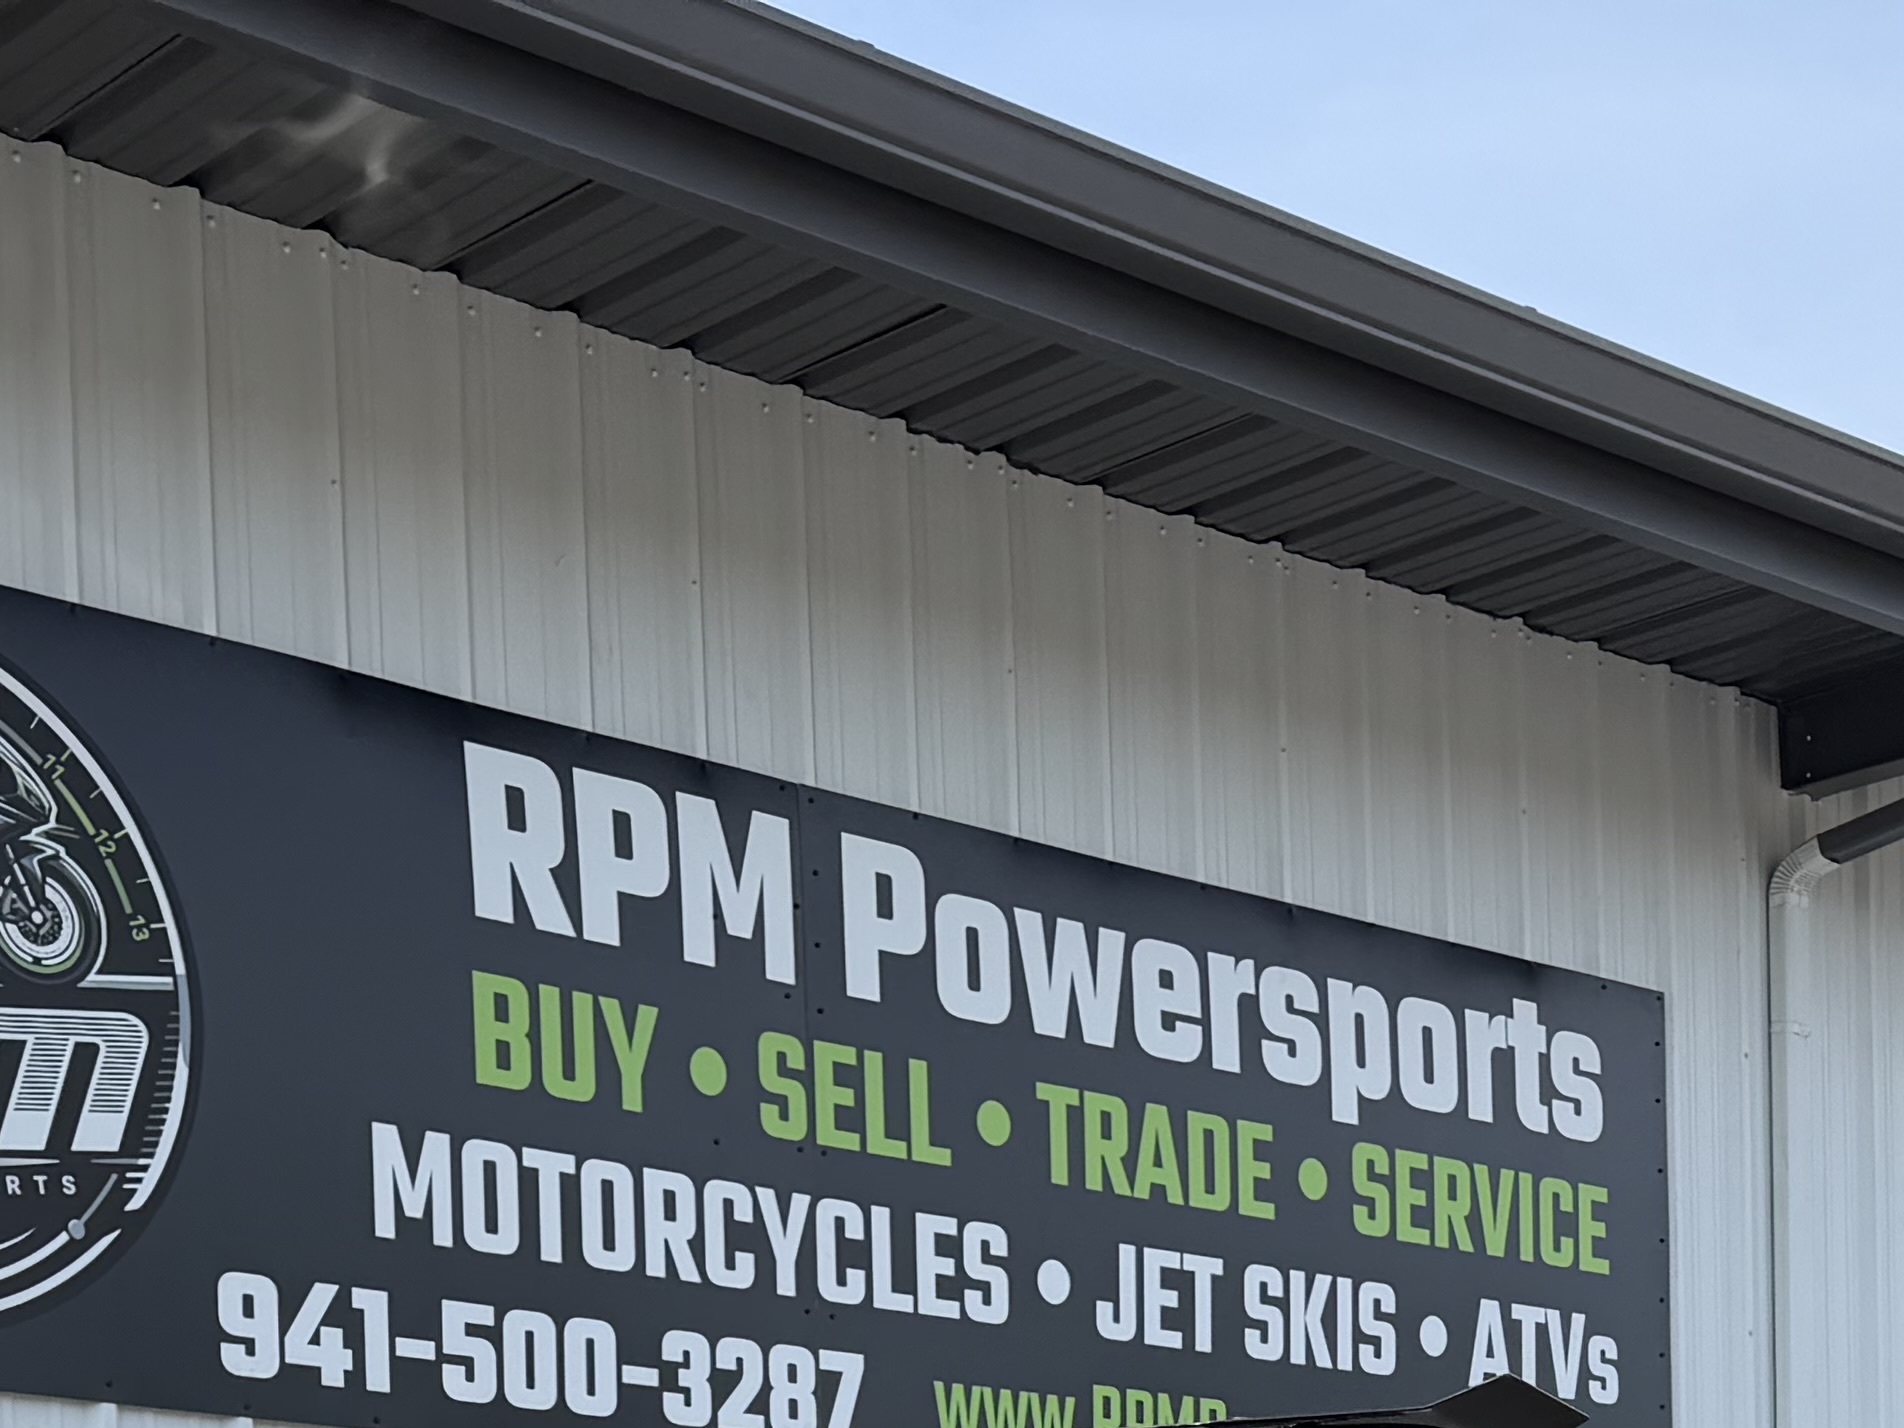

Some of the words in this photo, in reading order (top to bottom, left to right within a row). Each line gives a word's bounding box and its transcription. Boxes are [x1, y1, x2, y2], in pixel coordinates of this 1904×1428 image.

[41, 754, 66, 781] 11
[91, 829, 116, 858] 12
[127, 914, 149, 942] 13
[463, 740, 796, 985] RPM
[841, 832, 1603, 1143] Powersports
[371, 1121, 1010, 1325] MOTORCYCLES
[1095, 1243, 1223, 1353] JET
[1243, 1264, 1398, 1375] SKIS
[1468, 1298, 1619, 1404] ATVs
[472, 970, 659, 1113] BUY
[757, 1031, 952, 1166] SELL
[1035, 1082, 1276, 1221] TRADE
[1351, 1143, 1610, 1276] SERVICE
